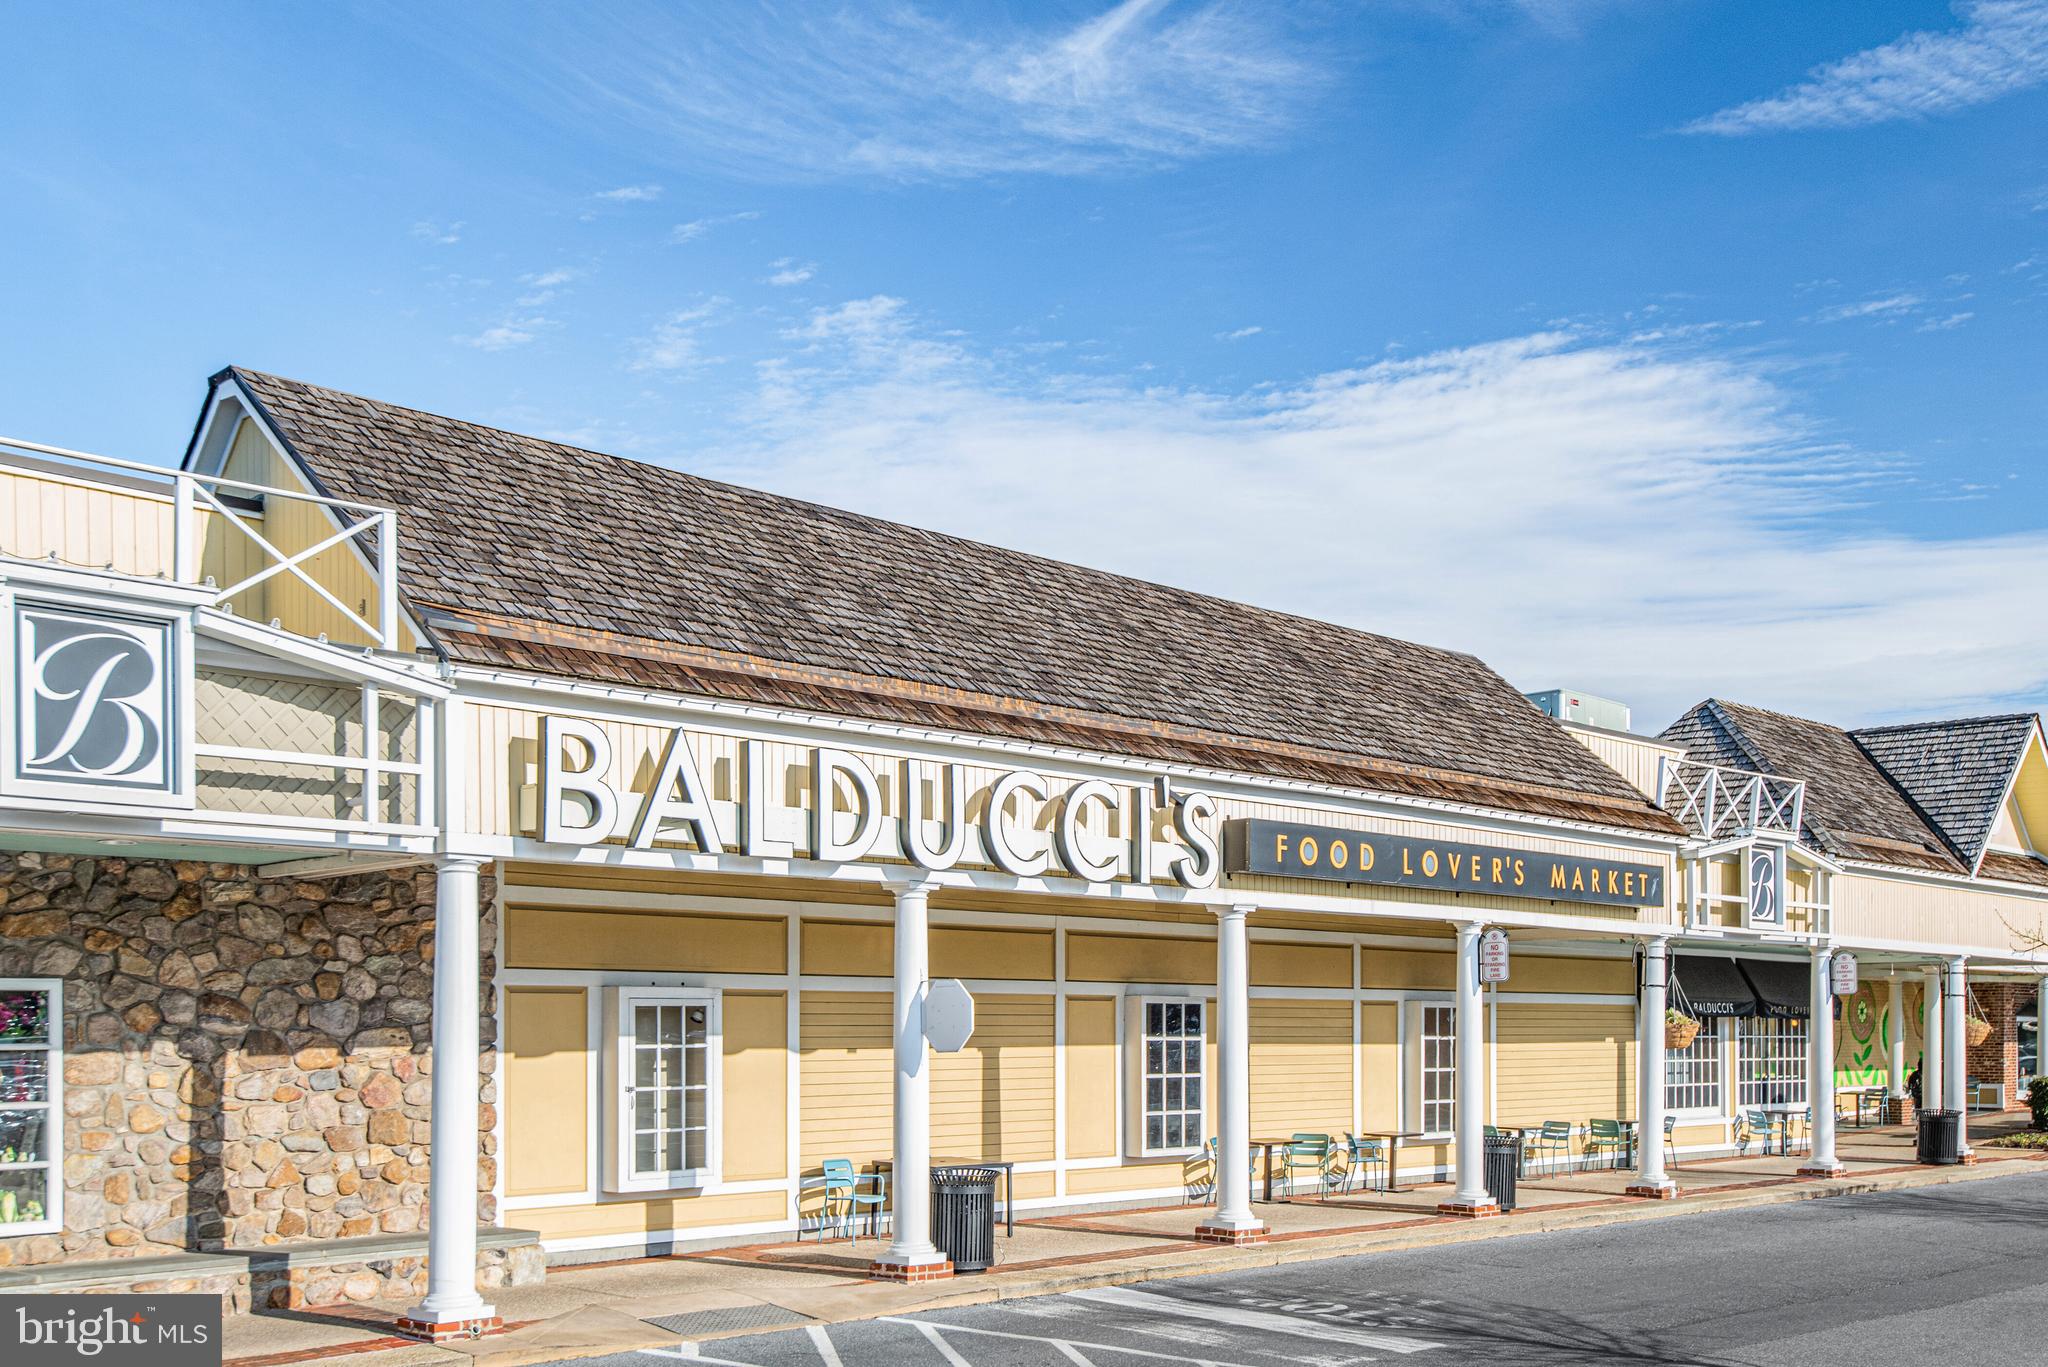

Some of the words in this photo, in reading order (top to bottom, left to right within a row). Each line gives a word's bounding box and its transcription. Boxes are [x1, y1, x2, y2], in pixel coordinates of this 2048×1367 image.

[21, 612, 164, 784] B
[537, 714, 1221, 889] BALDUCCI'S
[1276, 833, 1375, 871] FOOD
[1403, 847, 1525, 886] LOVER'S
[1551, 863, 1648, 897] MARKET
